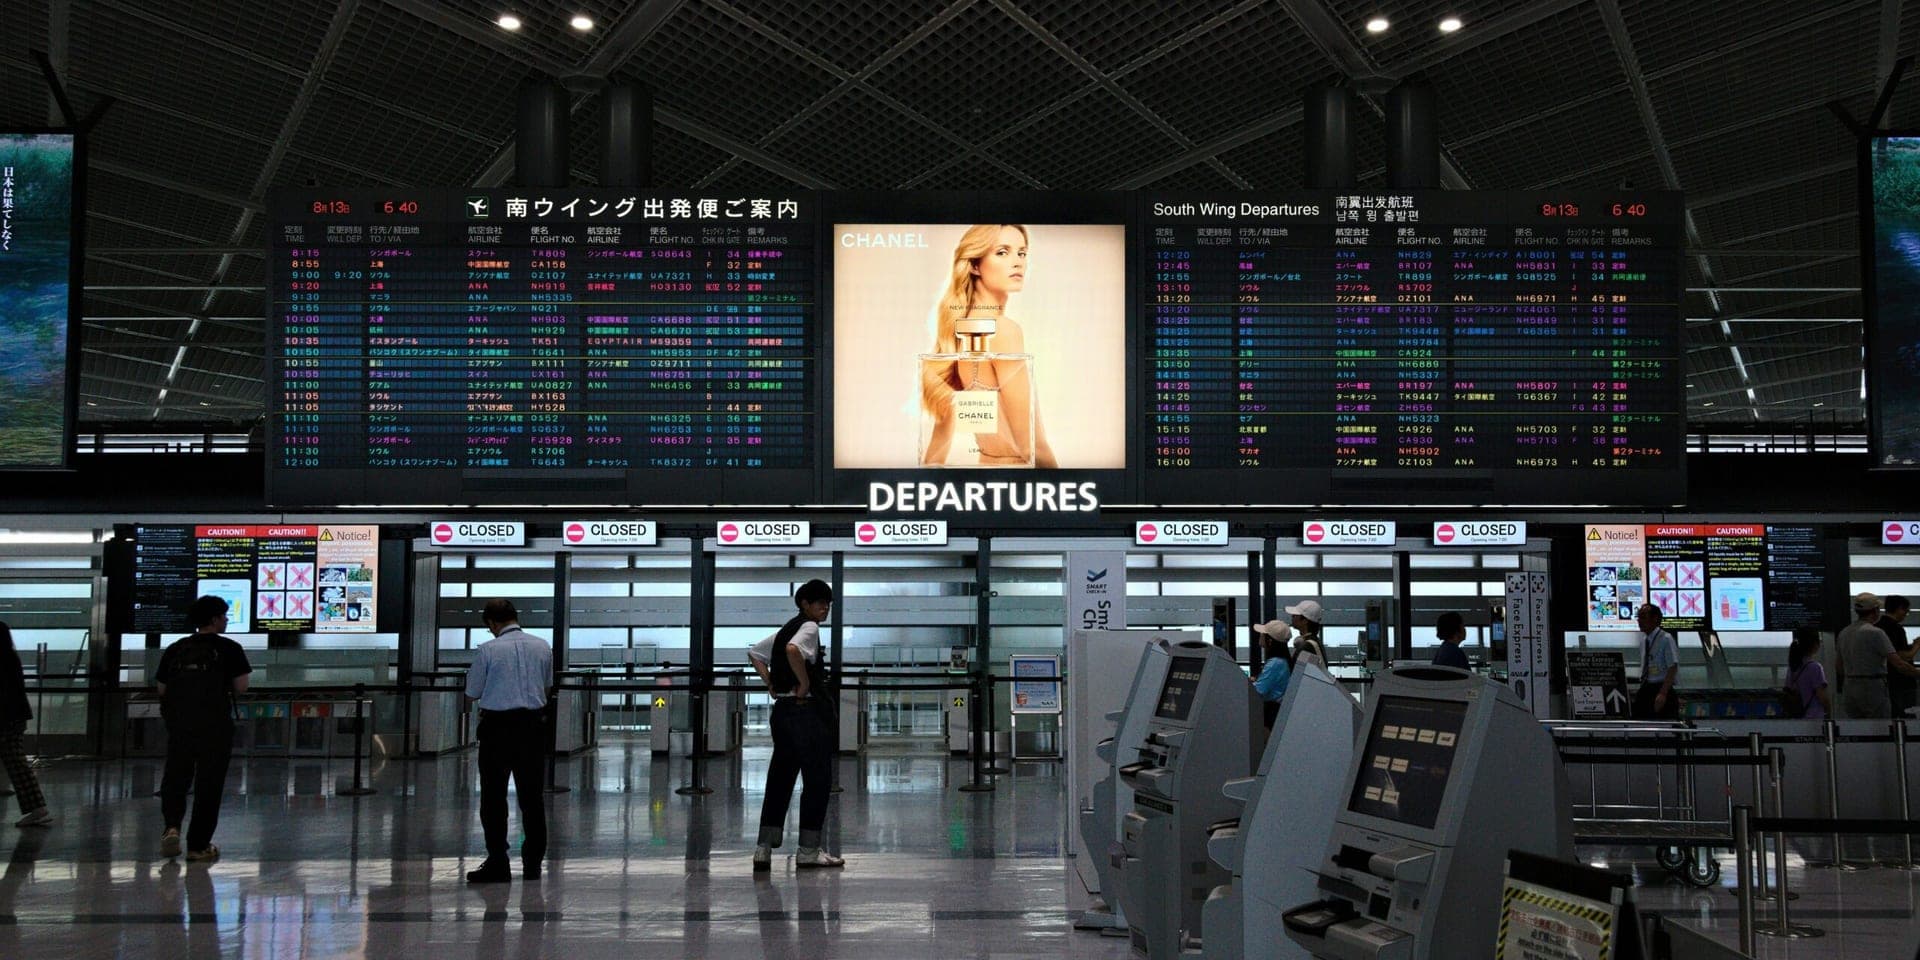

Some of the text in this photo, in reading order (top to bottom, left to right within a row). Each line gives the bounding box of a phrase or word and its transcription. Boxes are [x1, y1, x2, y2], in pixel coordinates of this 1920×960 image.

[1335, 195, 1414, 209] 南翼出发航班
[506, 197, 799, 220] 南ウイング出発便ご案内
[1153, 202, 1320, 220] South Wing Departures
[1335, 209, 1419, 222] 남쪽 윙 출발편
[284, 235, 304, 244] TIME
[468, 235, 501, 244] AIRLINE
[530, 235, 560, 244] FLIGHT
[561, 235, 576, 244] NO.
[587, 235, 620, 244] AIRLINE
[649, 235, 678, 244] FLIGHT
[680, 235, 696, 244] NO.
[747, 235, 788, 244] REMARKS
[841, 232, 929, 249] CHANEL
[1156, 237, 1175, 245] TIME
[1335, 237, 1368, 245] AIRLINE
[1397, 237, 1427, 245] FLIGHT
[1427, 237, 1442, 245] NO.
[1453, 237, 1486, 245] AIRLINE
[1514, 237, 1544, 245] FLIGHT
[1611, 237, 1653, 245] REMARKS
[291, 260, 741, 270] 8:55 CA158 32
[291, 271, 741, 280] 9:00 9:20 ソウル OZ107 UA7321 33
[291, 282, 320, 290] 9:20
[467, 282, 489, 291] ANA
[531, 282, 566, 291] NH919
[726, 283, 741, 291] 52
[291, 293, 573, 302] 9:30 マニラ ANA NH5335
[1155, 295, 1606, 303] 13:20 ソウル OZ101 ANA NH6971 45
[284, 359, 319, 367] 10:55
[531, 359, 566, 368] BX111
[650, 359, 692, 368] OZ9711
[284, 381, 741, 390] 11:00 UA0827 ANA NH6456 33
[284, 392, 566, 401] 11:05 BX163
[1155, 393, 1191, 401] 14:25
[1398, 393, 1440, 401] TK9447
[1516, 393, 1558, 401] TG6367
[1592, 393, 1606, 401] 42
[958, 412, 995, 420] CHANEL
[1155, 425, 1606, 434] 15:15 CA926 ANA NH5703 32
[1155, 447, 1191, 456] 16:00
[1398, 447, 1440, 456] NH5902
[284, 458, 741, 467] 12:00 TK8372 41
[1155, 458, 1606, 466] 16:00 ソウル OZ103 ANA NH6973 45
[869, 482, 1098, 512] DEPARTURES
[336, 529, 371, 541] Notice!
[459, 524, 515, 536] CLOSED
[590, 524, 646, 536] CLOSED
[744, 524, 800, 536] CLOSED
[882, 524, 938, 536] CLOSED
[1163, 524, 1219, 536] CLOSED
[1331, 524, 1386, 536] CLOSED
[1461, 524, 1517, 536] CLOSED
[1604, 529, 1638, 541] Notice!
[1657, 528, 1694, 536] CAUTION!!
[1716, 528, 1754, 536] CAUTION!!
[1535, 598, 1544, 622] Face
[1513, 598, 1524, 664] Face Express
[1535, 623, 1544, 664] Express
